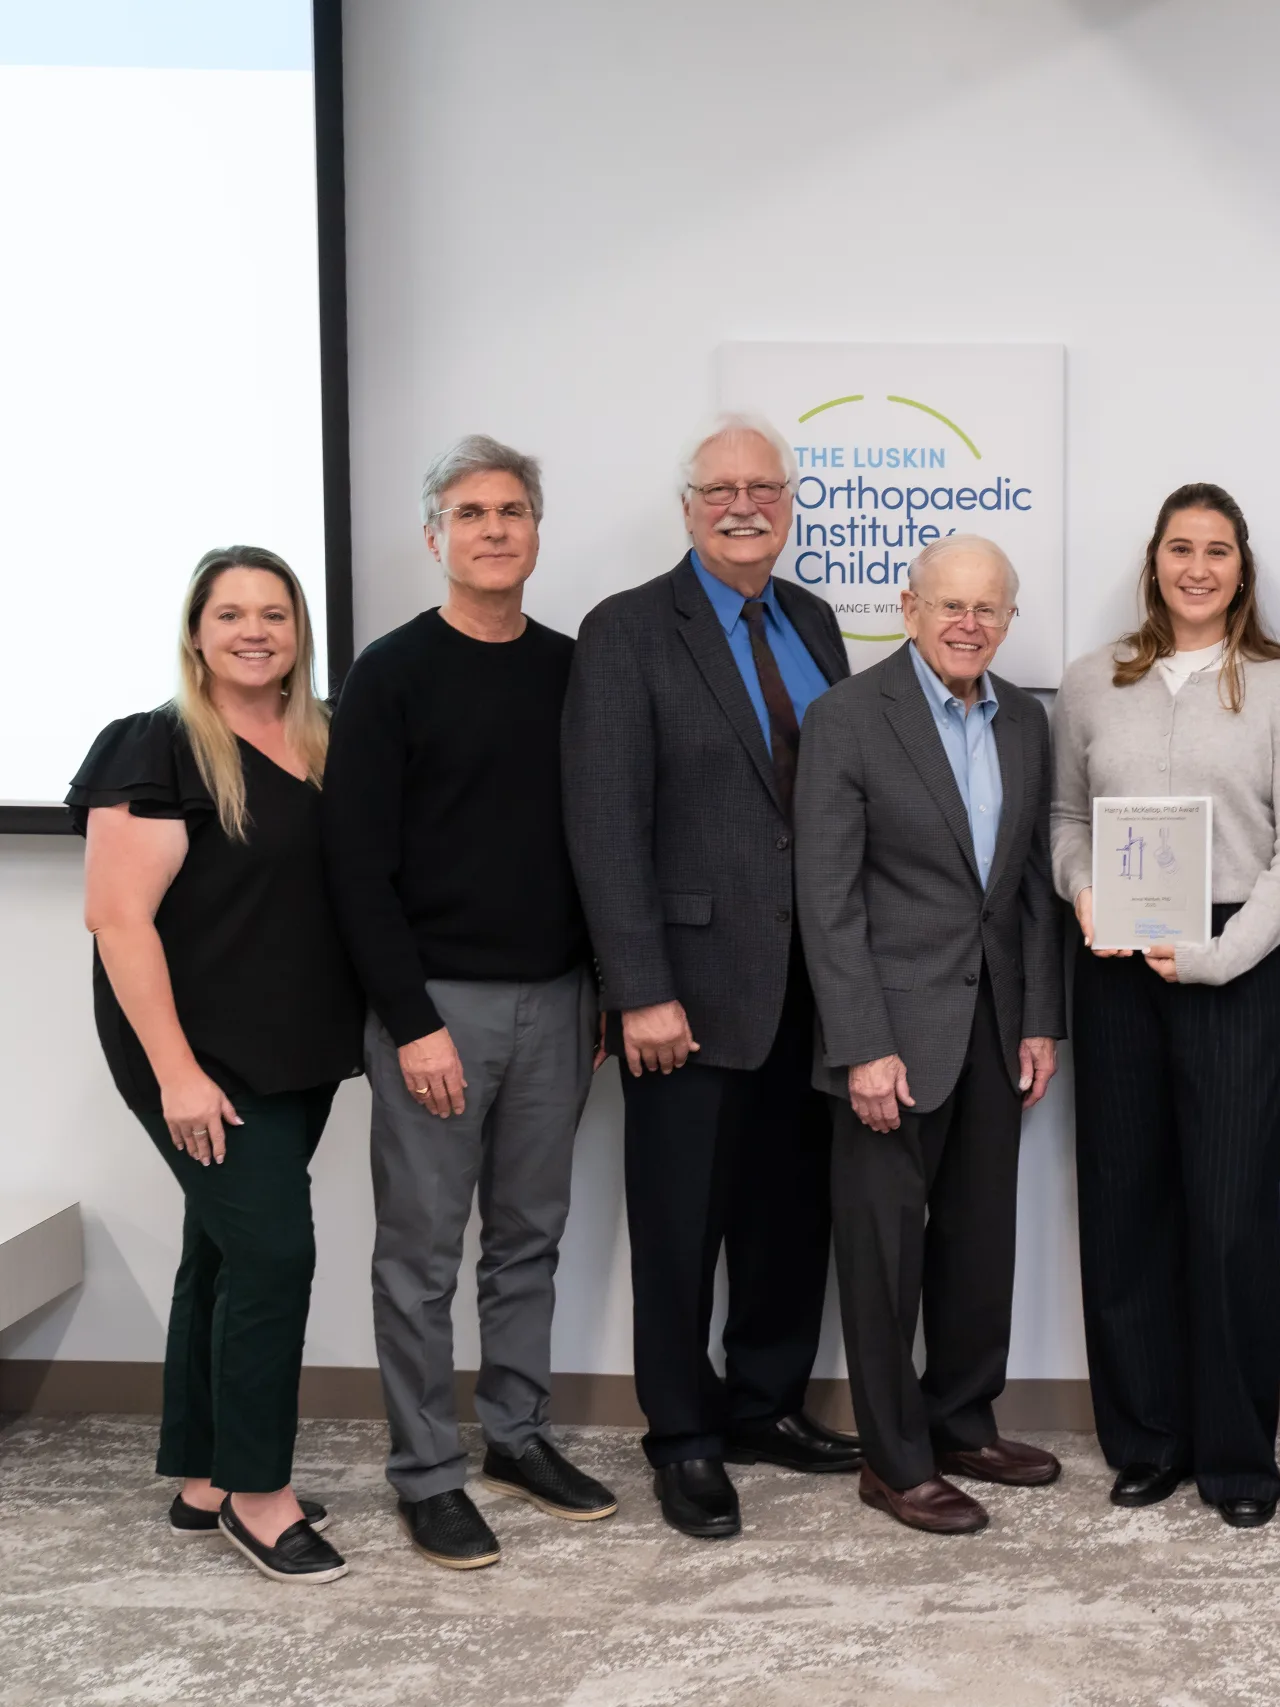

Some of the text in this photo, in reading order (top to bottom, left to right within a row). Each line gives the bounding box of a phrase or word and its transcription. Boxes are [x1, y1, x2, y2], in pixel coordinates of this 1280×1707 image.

[794, 447, 945, 468] THE LUSKIN
[795, 476, 1032, 520] Orthopaedic
[796, 514, 941, 547] Institute
[795, 550, 911, 584] Childr
[835, 603, 904, 613] IANCE WITH
